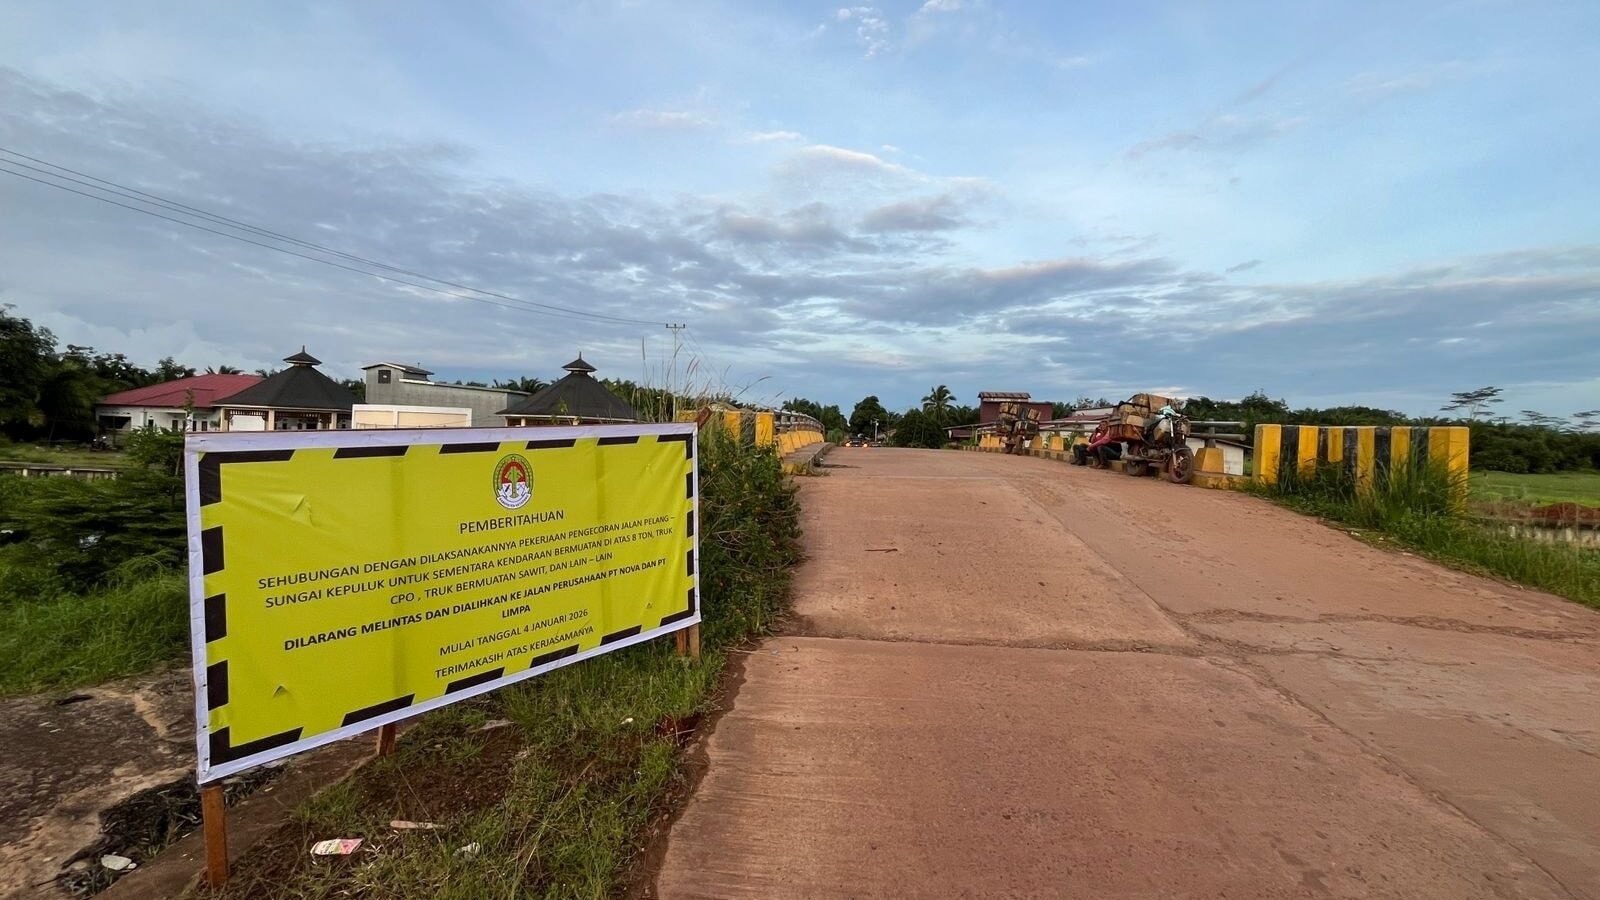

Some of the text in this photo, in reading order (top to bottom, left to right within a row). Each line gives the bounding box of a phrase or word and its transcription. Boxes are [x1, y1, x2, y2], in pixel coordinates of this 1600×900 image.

[460, 510, 564, 534] PEMBERITAHUAN
[258, 566, 359, 589] SEHUBUNGAN
[364, 558, 416, 573] DENGAN
[420, 541, 516, 564] DILAKSANAKANNYA
[519, 533, 566, 547] PEKERJAAN
[569, 524, 619, 538] PENGECORAN
[622, 520, 642, 530] JALAN
[644, 515, 669, 525] PELANG
[266, 590, 321, 608] SUNGAI
[327, 580, 384, 597] KEPULUK
[389, 572, 429, 587] UNTUK
[433, 562, 494, 579] SEMENTARA
[497, 551, 552, 567] KENDARAAN
[555, 541, 602, 557] BERMUATAN
[604, 538, 612, 546] DI
[614, 536, 630, 545] ATAS
[638, 531, 654, 540] TON,
[656, 528, 673, 536] TRUK
[390, 592, 414, 604] CPO
[424, 585, 453, 598] TRUK
[456, 573, 515, 592] BERMUATAN
[519, 565, 548, 579] SAWIT,
[550, 562, 567, 572] DAN
[570, 557, 587, 568] LAIN
[596, 552, 612, 562] LAIN
[284, 558, 666, 650] DILARANG MELINTAS DAN DIALIHKAN KE JALAN PERUSAHAAN PT NOVA DAN PT
[502, 605, 531, 618] LIMPA
[435, 626, 594, 678] TERIMAKASIH ATAS KERJASAMANYA
[440, 639, 474, 655] MULAI
[477, 626, 523, 643] TANGGAL
[531, 615, 567, 631] JANUARI
[569, 609, 588, 621] 2026
